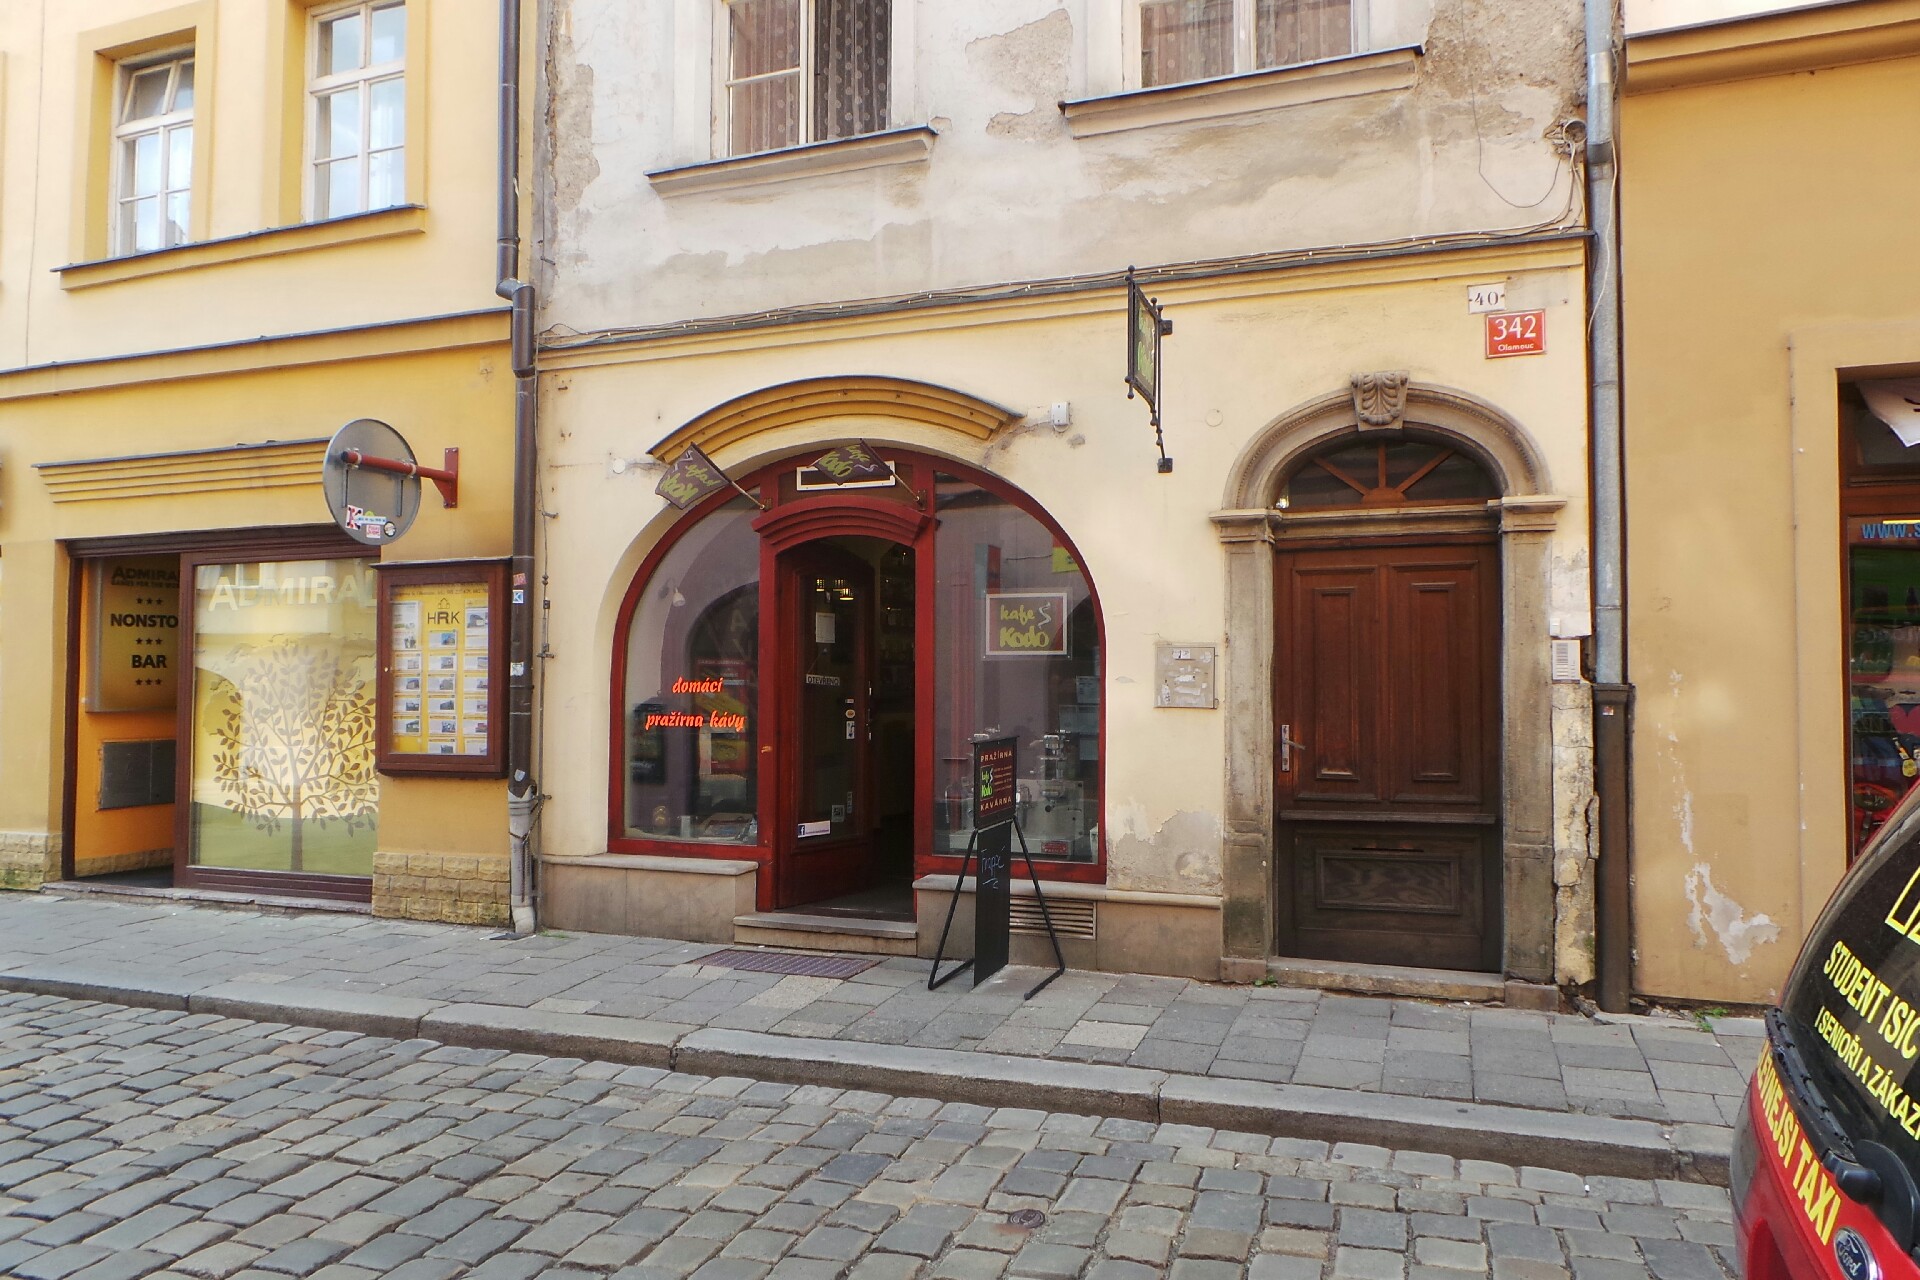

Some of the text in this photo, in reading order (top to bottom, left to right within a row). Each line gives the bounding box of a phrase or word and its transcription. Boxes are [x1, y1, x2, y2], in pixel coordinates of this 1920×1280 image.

[1474, 291, 1499, 306] 40
[1493, 315, 1537, 341] 342
[1497, 343, 1535, 352] Olomouc
[208, 573, 377, 612] ADMIRAL
[110, 613, 179, 628] NONSTO
[427, 611, 460, 625] HRK
[1000, 604, 1035, 626] kafe
[1000, 625, 1050, 648] Kodo
[131, 655, 168, 669] BAR
[672, 676, 724, 693] domácí
[645, 710, 745, 732] pražírna kávy
[980, 796, 1012, 811] KAVÁRNA
[1823, 940, 1892, 1024] STUDENT
[1878, 995, 1920, 1059] ISIC
[1818, 1010, 1863, 1071] SENIOŘI
[1855, 1055, 1872, 1085] A
[1865, 1064, 1920, 1141] ZÁKAZ
[1792, 1137, 1842, 1246] TAXI
